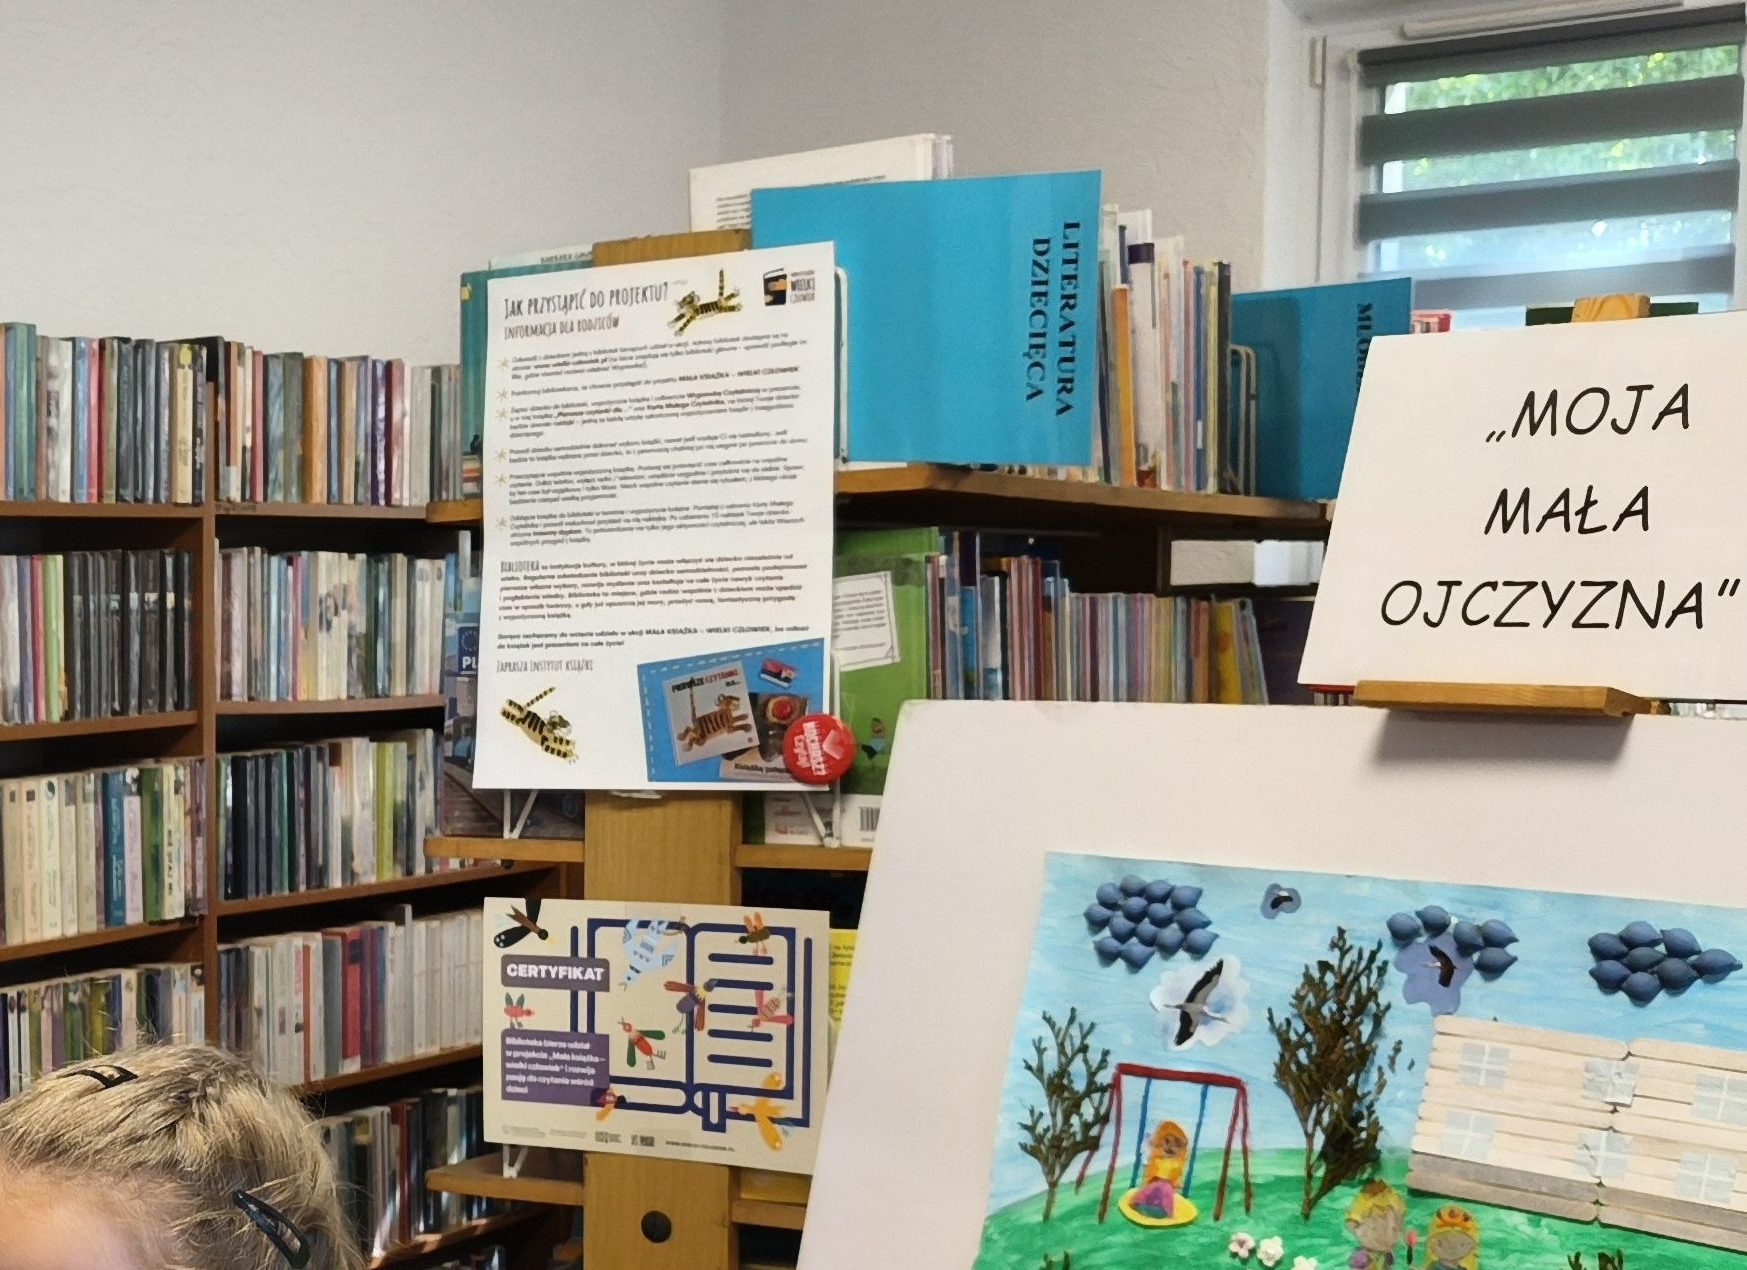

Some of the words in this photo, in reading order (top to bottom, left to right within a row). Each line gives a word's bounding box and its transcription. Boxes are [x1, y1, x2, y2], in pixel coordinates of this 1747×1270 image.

[504, 299, 523, 320] JAK
[528, 288, 586, 316] PRZYSTĄPIĆ
[589, 290, 604, 309] DO
[1024, 236, 1051, 402] DZIECIĘCA
[1056, 220, 1081, 418] LITERATURA
[504, 321, 556, 340] INFORMACJA
[559, 320, 574, 334] DLA
[1485, 383, 1692, 443] „MOJA
[1484, 485, 1651, 535] MAŁA
[506, 963, 605, 981] CERTYFIKAT
